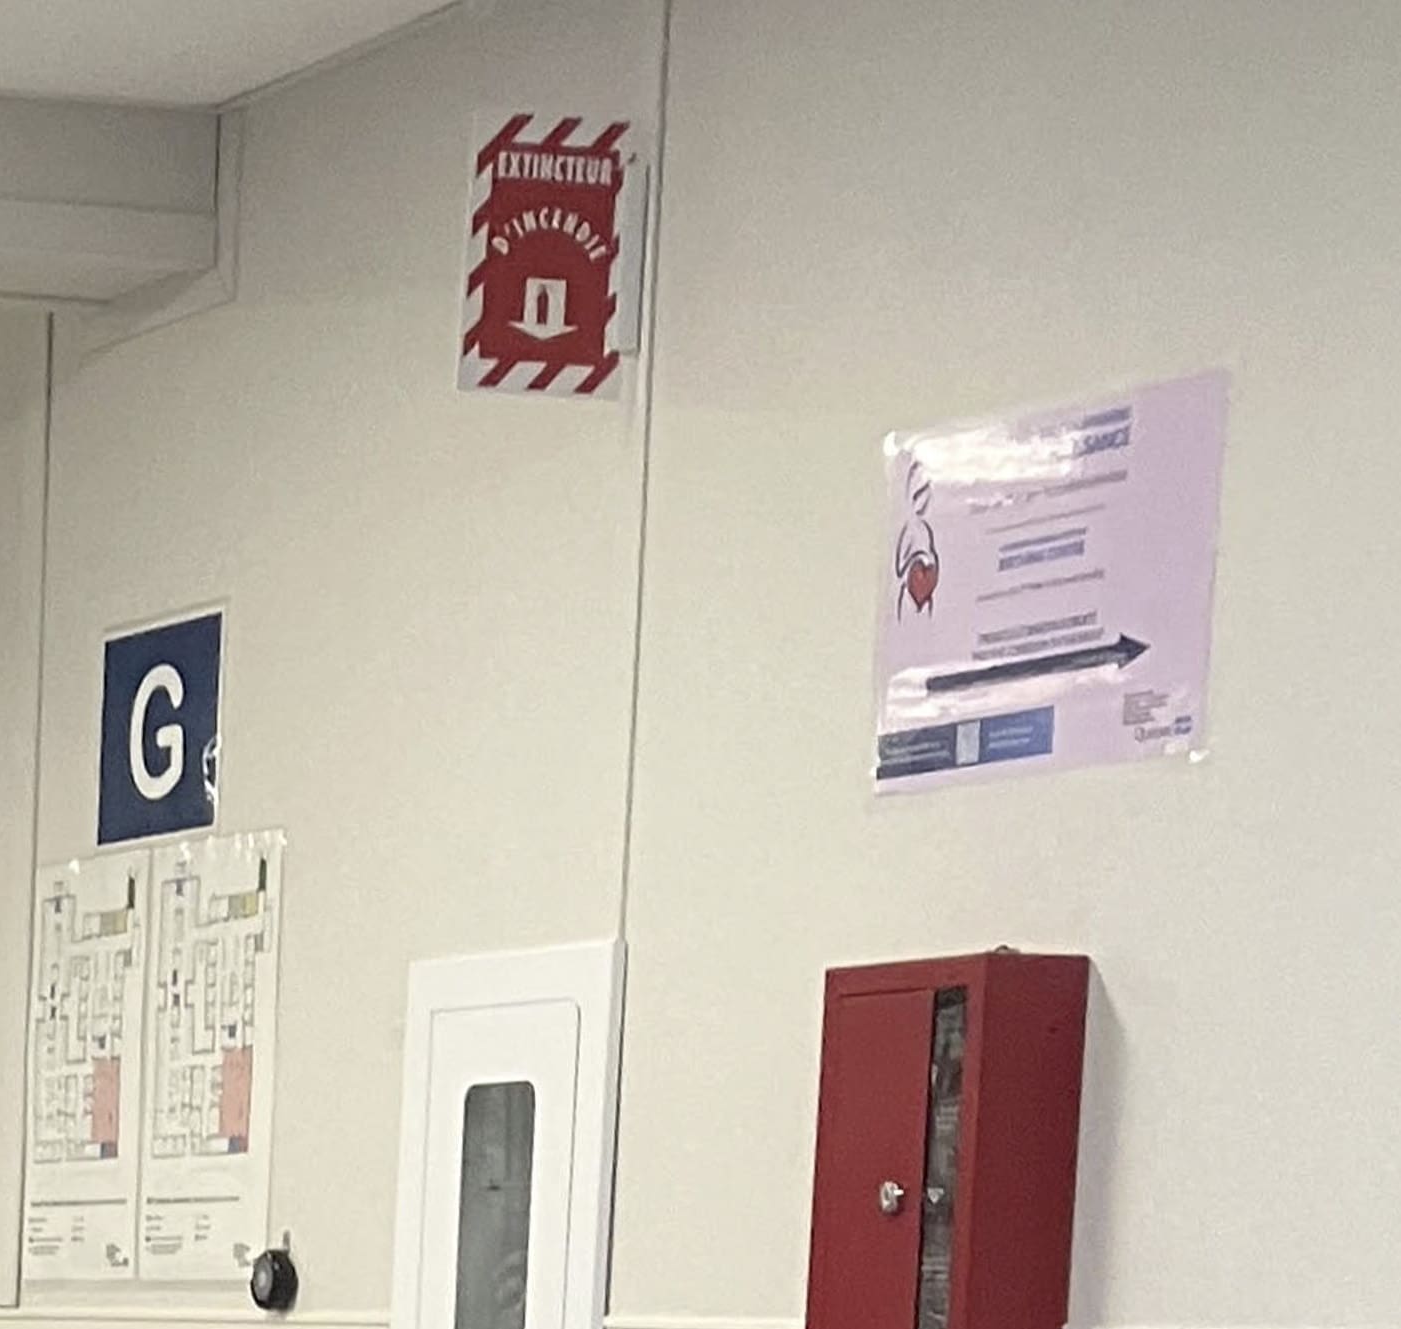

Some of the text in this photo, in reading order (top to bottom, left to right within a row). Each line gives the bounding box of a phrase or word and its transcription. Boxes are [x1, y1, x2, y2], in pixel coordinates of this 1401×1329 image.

[498, 151, 612, 185] EXTINCTEUR
[492, 206, 606, 261] D'INCENDIE
[128, 663, 186, 801] G
